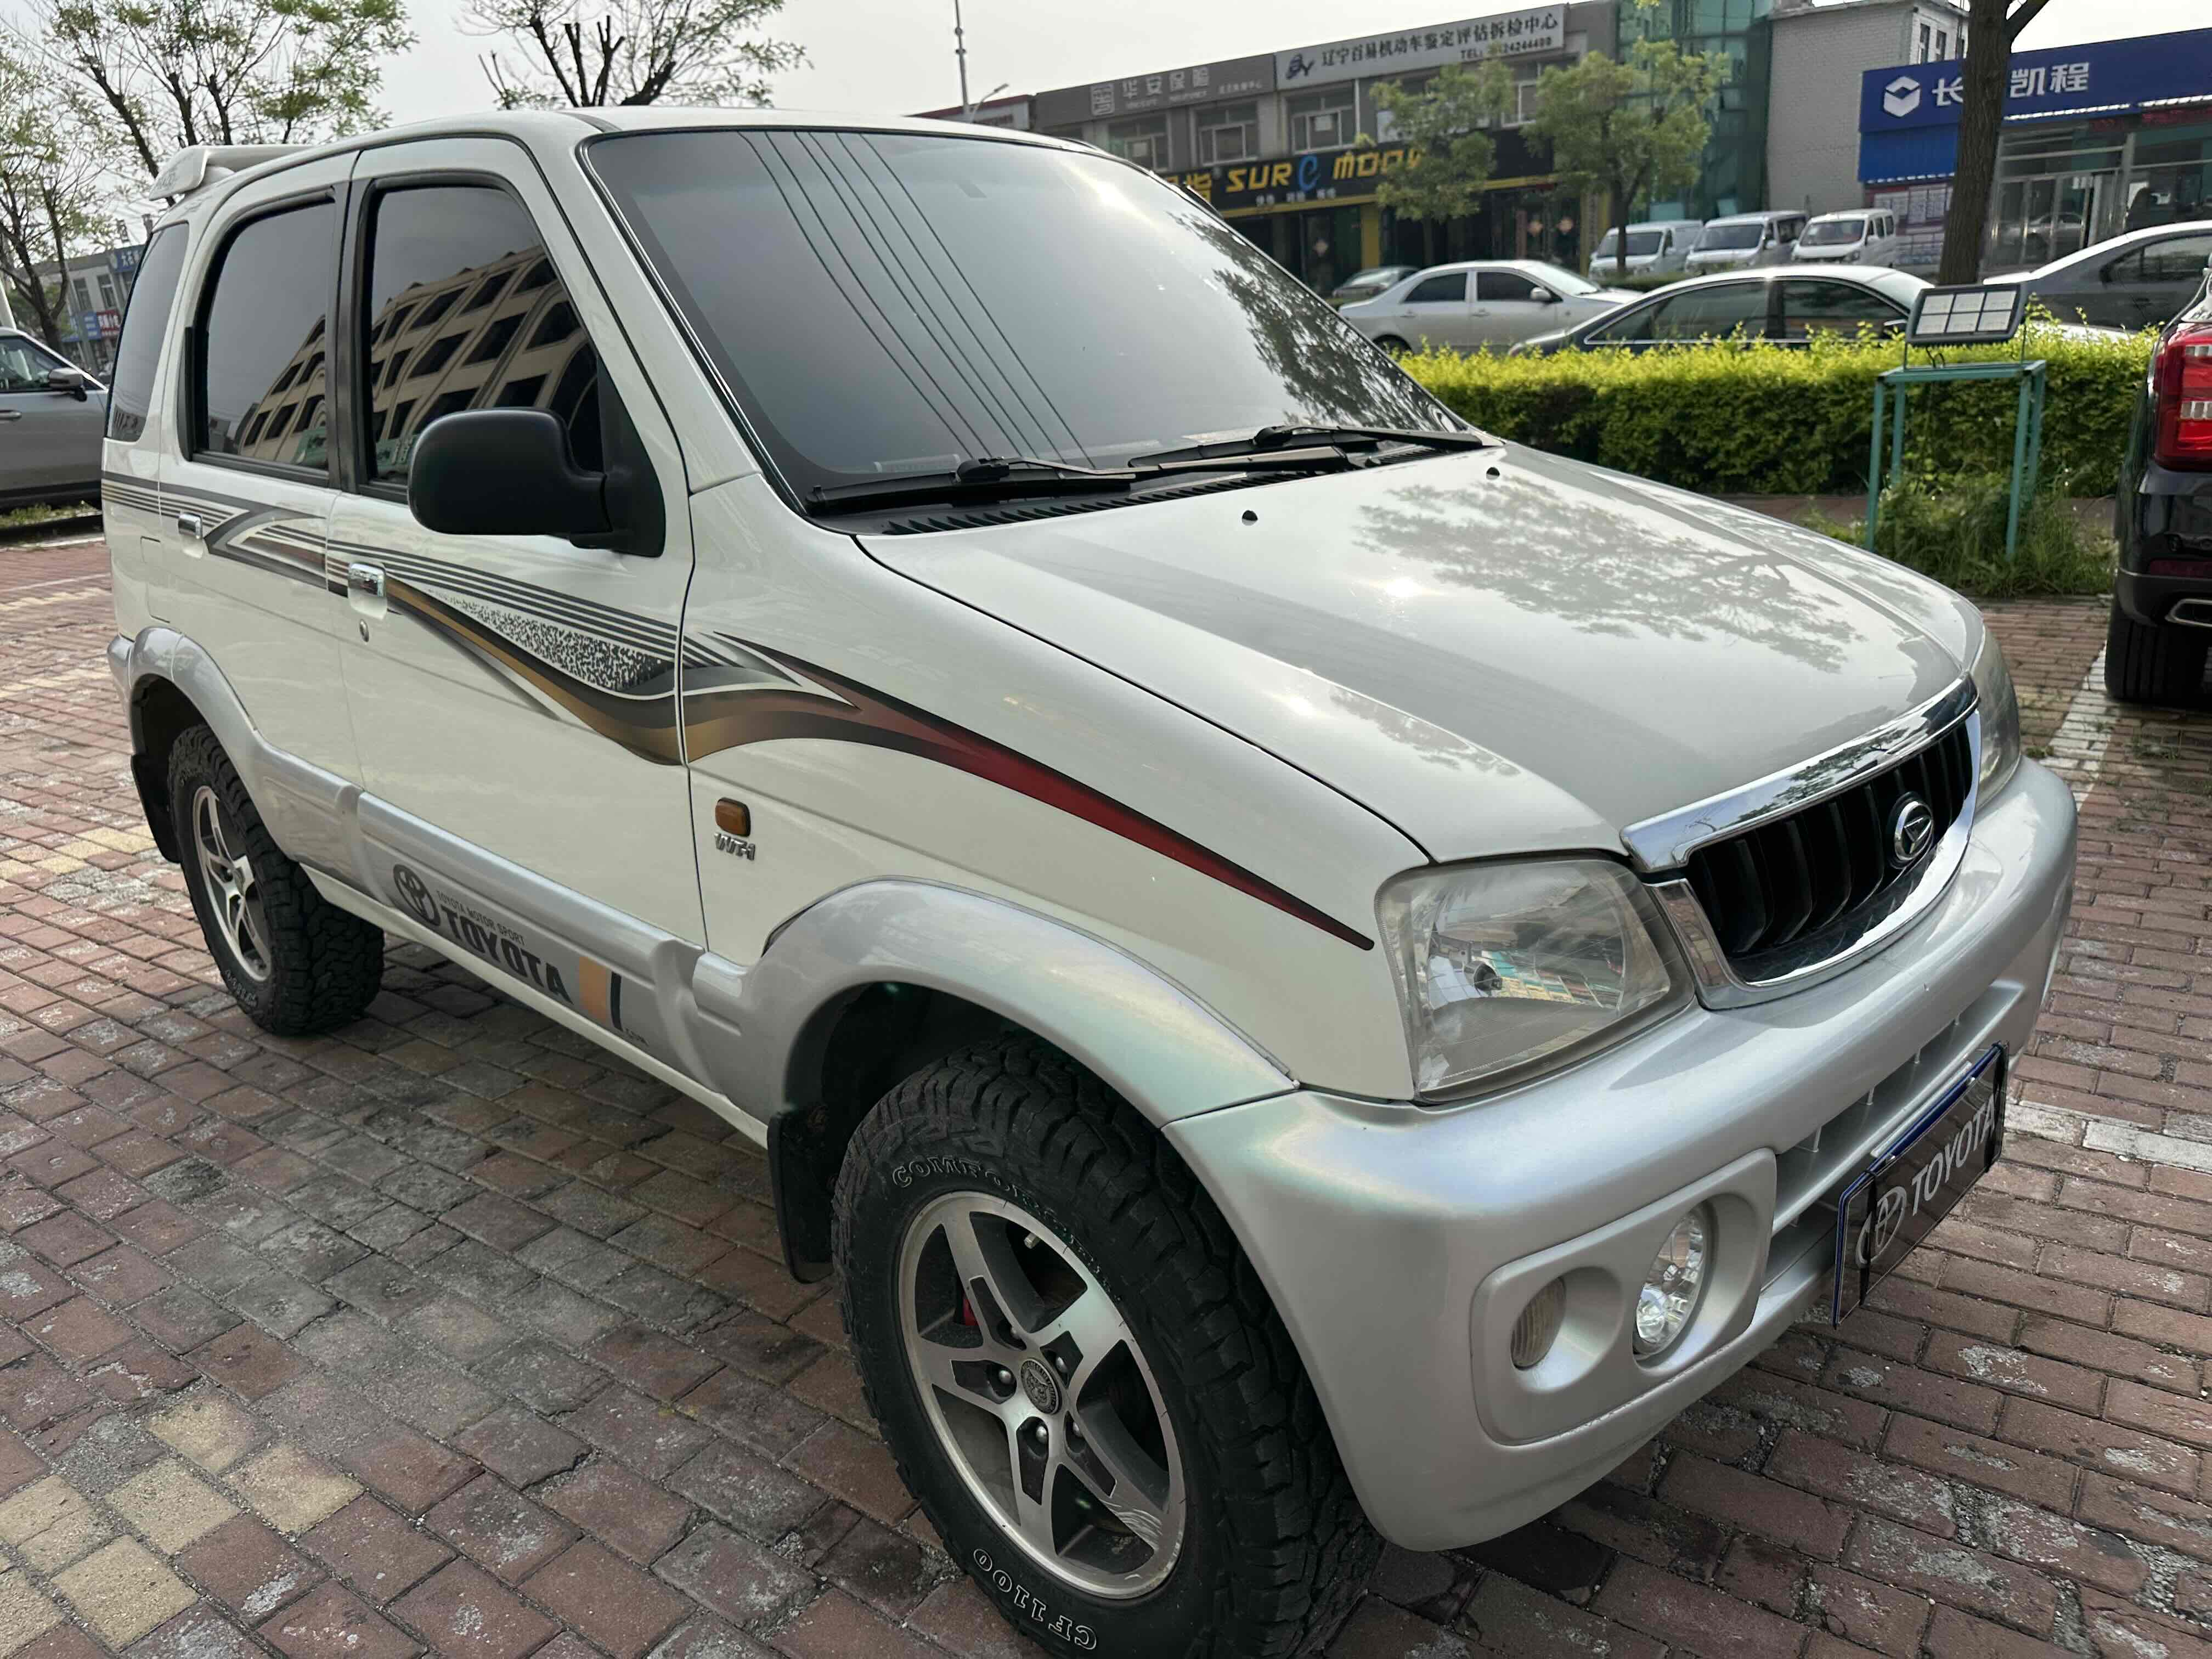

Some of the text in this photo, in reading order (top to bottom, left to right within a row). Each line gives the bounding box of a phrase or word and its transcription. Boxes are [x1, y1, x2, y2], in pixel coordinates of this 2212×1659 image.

[1122, 66, 1209, 99] 华安保险
[1932, 61, 2090, 106] 长凯程
[437, 890, 525, 946] TOYOTA MOTOR SPORT
[440, 905, 574, 1005] TOYOTA
[1911, 1093, 1995, 1216] TOYOTA
[973, 1548, 1097, 1650] CF1100
